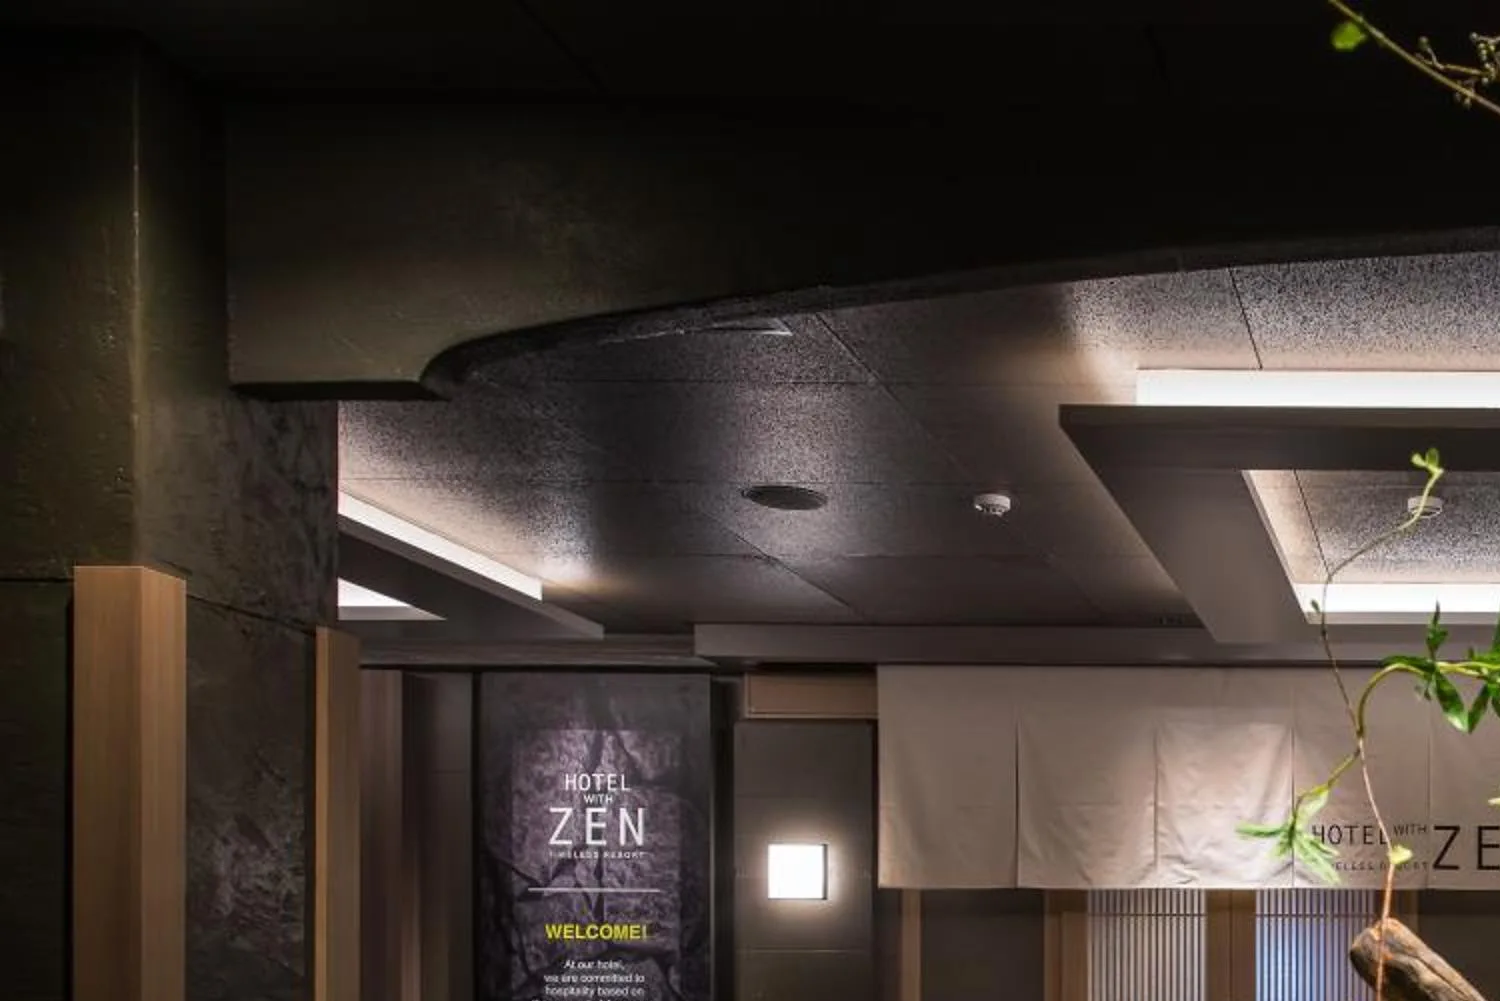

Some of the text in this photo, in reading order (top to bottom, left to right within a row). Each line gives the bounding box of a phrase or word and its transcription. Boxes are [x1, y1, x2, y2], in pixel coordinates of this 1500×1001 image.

[565, 773, 631, 791] HOTEL
[584, 794, 613, 804] WITH
[548, 807, 645, 846] ZEN
[1312, 824, 1391, 845] HOTEL
[1394, 824, 1427, 836] WITH
[544, 923, 648, 940] WELCOME!
[563, 959, 575, 970] At
[577, 959, 595, 970] our
[543, 975, 645, 983] we are committed to
[545, 986, 645, 998] hospitality based on
